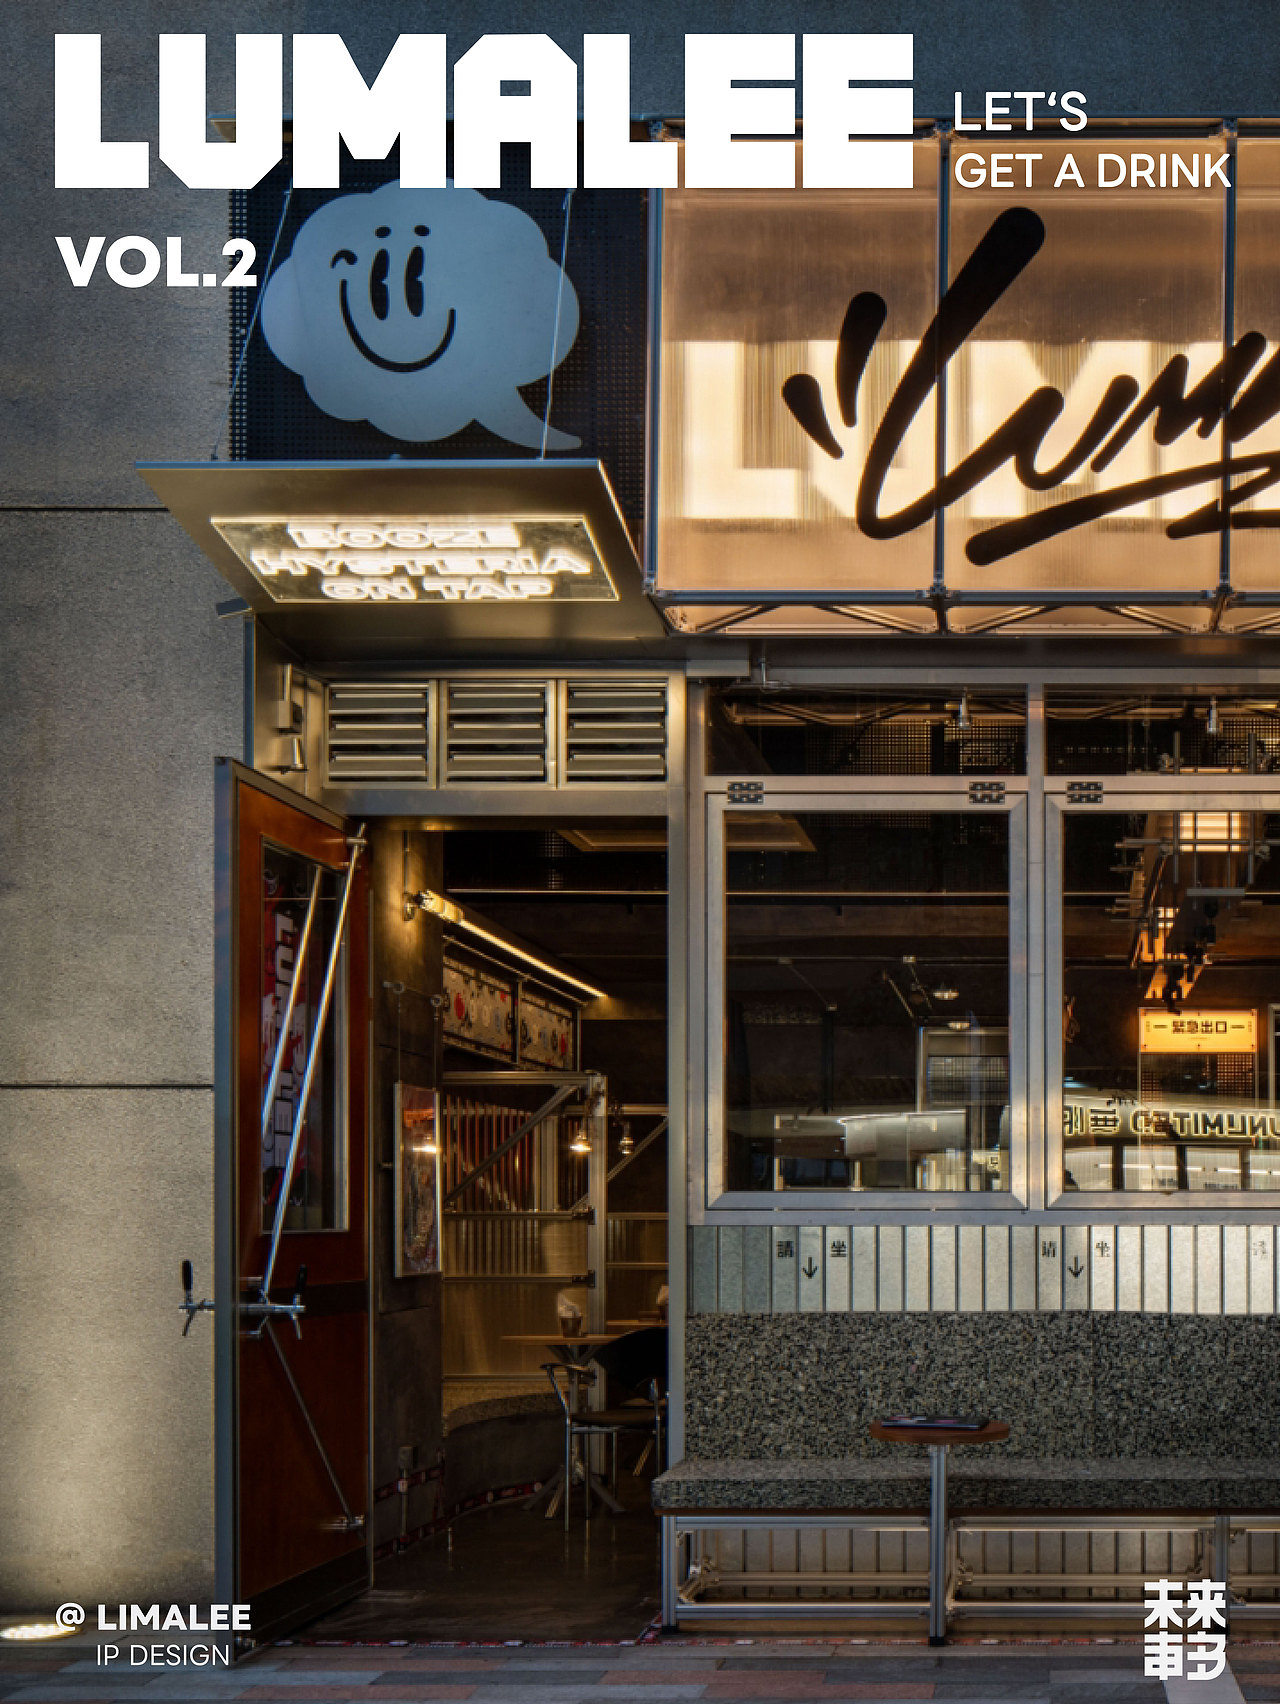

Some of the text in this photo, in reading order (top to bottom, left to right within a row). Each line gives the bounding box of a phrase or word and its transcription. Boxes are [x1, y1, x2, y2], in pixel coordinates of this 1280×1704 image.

[322, 575, 554, 600] ON TAP
[1172, 1020, 1228, 1035] 緊急出口
[830, 1239, 848, 1258] 坐
